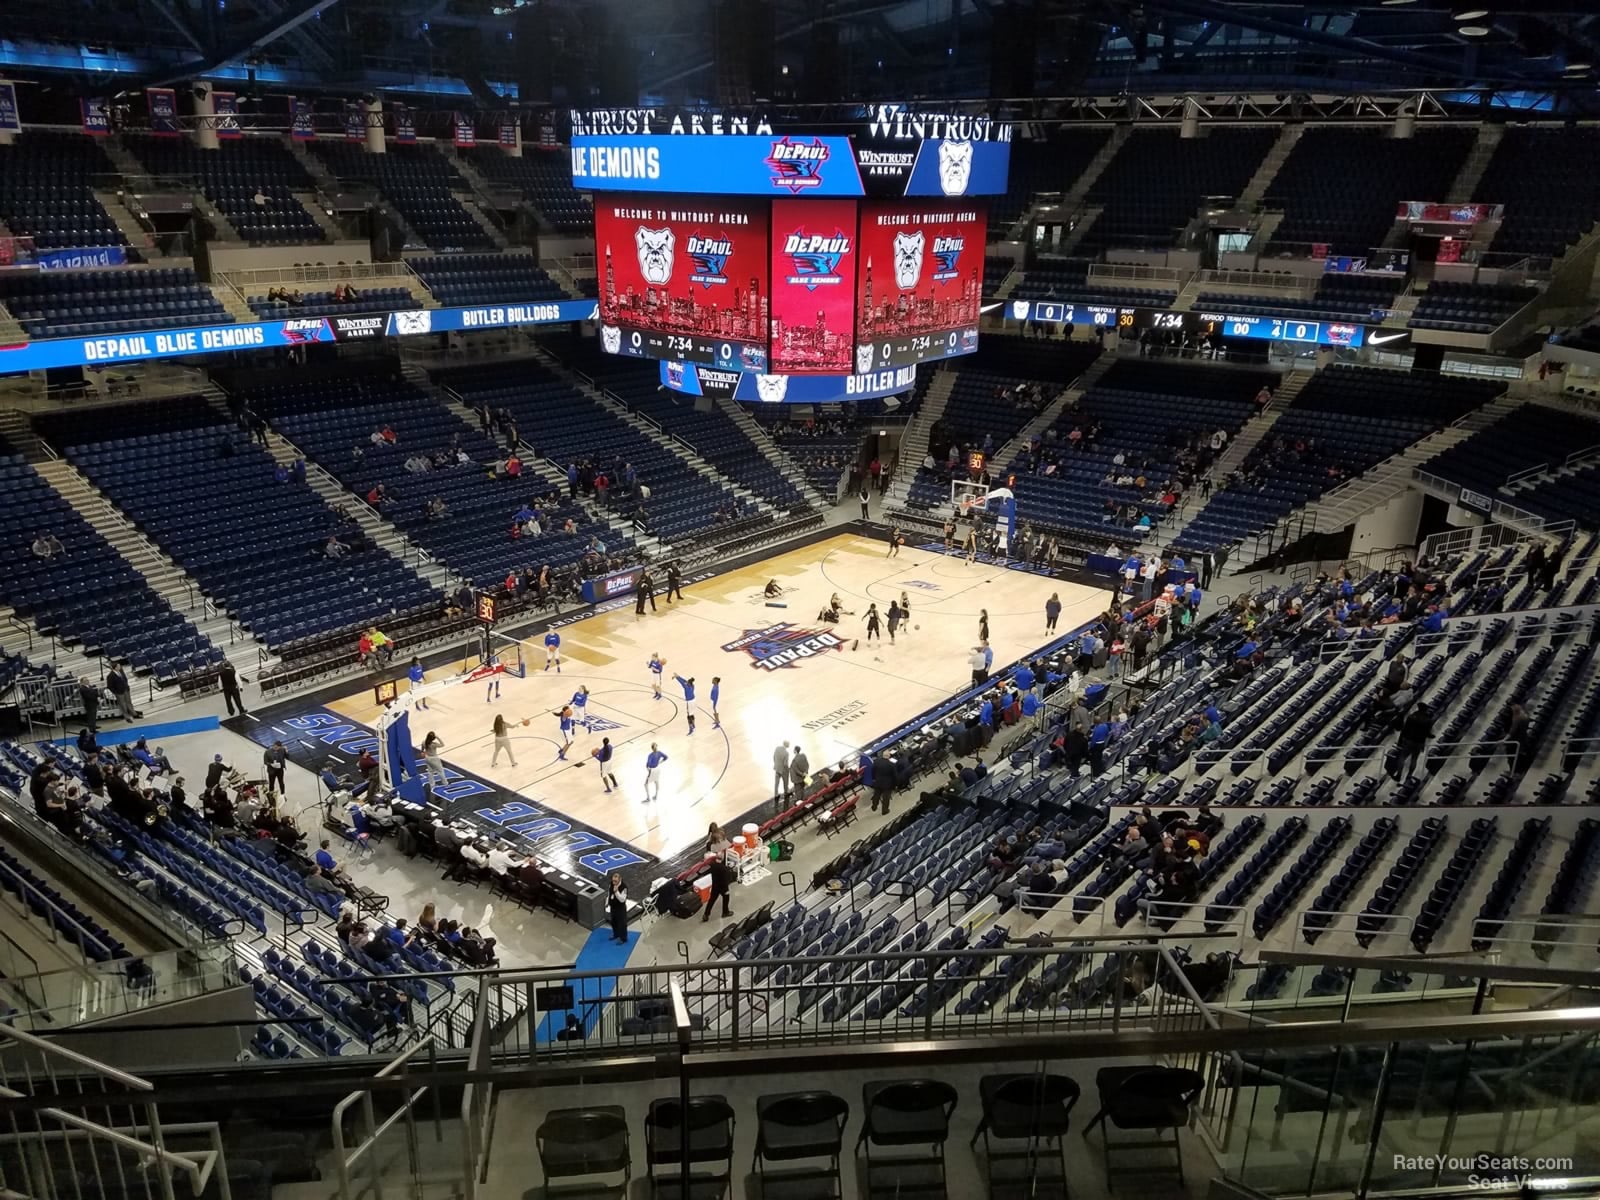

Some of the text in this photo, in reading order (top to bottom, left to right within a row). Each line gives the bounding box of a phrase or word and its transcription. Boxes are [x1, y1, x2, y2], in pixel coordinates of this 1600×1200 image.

[671, 114, 773, 135] ARENA
[869, 104, 993, 142] WINTRUST
[591, 147, 660, 179] DEMONS
[859, 151, 913, 164] WINTRUST
[870, 167, 902, 175] ARENA
[614, 208, 748, 225] WELCOME TO WINTRUST ARENA
[877, 212, 976, 225] WELCOME TO WINTRUST ARENA
[462, 305, 560, 327] BUTLER BULLDOGS
[1046, 306, 1053, 318] 0
[1065, 310, 1073, 322] 4
[1094, 313, 1107, 325] 00
[1200, 313, 1224, 322] PERIOD
[337, 316, 382, 329] WINTRUST
[1120, 314, 1134, 326] 30
[1153, 313, 1183, 328] 7:34
[1208, 322, 1214, 332] 1
[347, 328, 374, 337] ARENA
[1233, 323, 1249, 335] 00
[1271, 326, 1280, 338] 4
[1296, 325, 1305, 338] 0
[84, 327, 264, 361] DEPAUL BLUE DEMONS
[632, 332, 642, 348] 0
[667, 335, 693, 351] 7:34
[911, 336, 931, 351] 7:34
[949, 332, 957, 347] 0
[721, 343, 732, 360] 0
[882, 343, 891, 359] 0
[697, 368, 738, 383] WINTRUST
[846, 371, 894, 395] BUTLER
[705, 381, 729, 389] ARENA
[546, 610, 594, 629] COURT
[801, 699, 865, 730] WINTRUST
[832, 710, 868, 730] ARENA
[474, 801, 650, 876] BLUE
